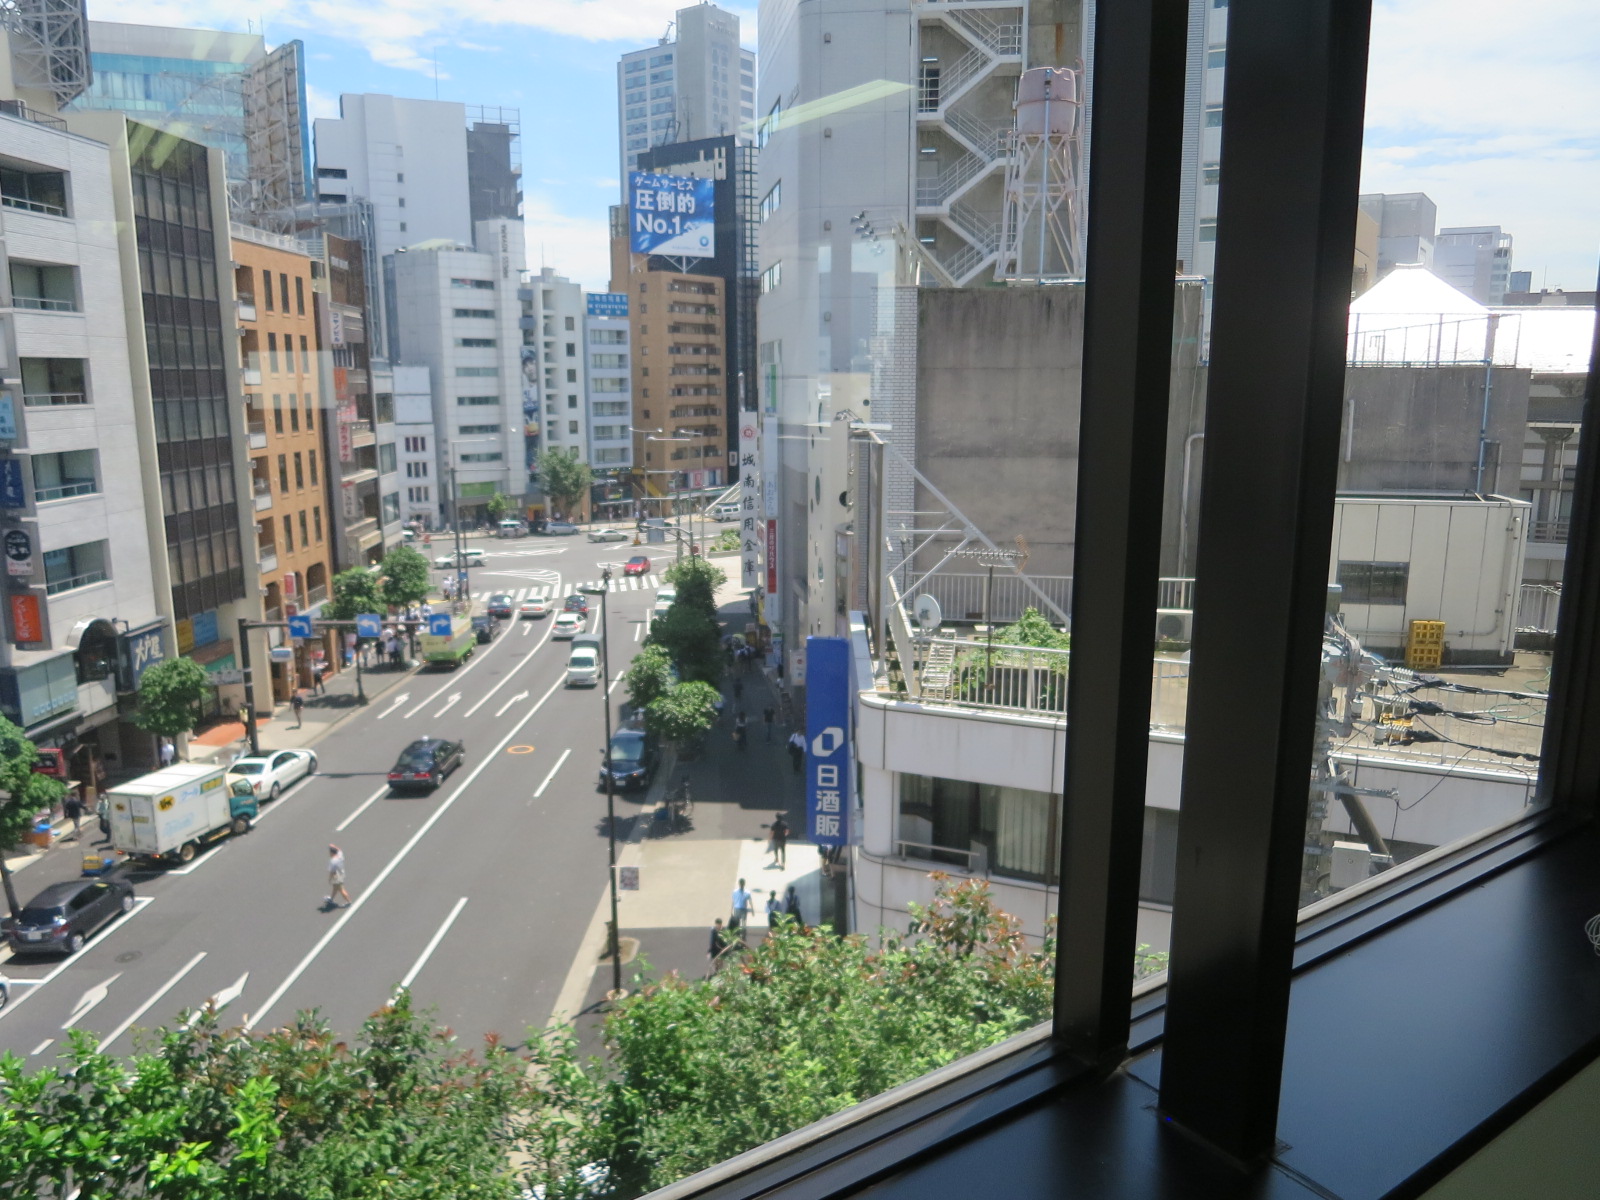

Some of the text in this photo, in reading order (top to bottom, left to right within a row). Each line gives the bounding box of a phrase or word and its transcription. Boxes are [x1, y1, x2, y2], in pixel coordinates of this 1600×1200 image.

[634, 175, 695, 191] ゲームサービス
[634, 189, 696, 215] 圧倒的
[340, 425, 350, 461] カラオケ
[741, 452, 757, 577] 城南信用金庫
[134, 634, 164, 671] 大戸屋
[815, 764, 841, 837] 日酒販
